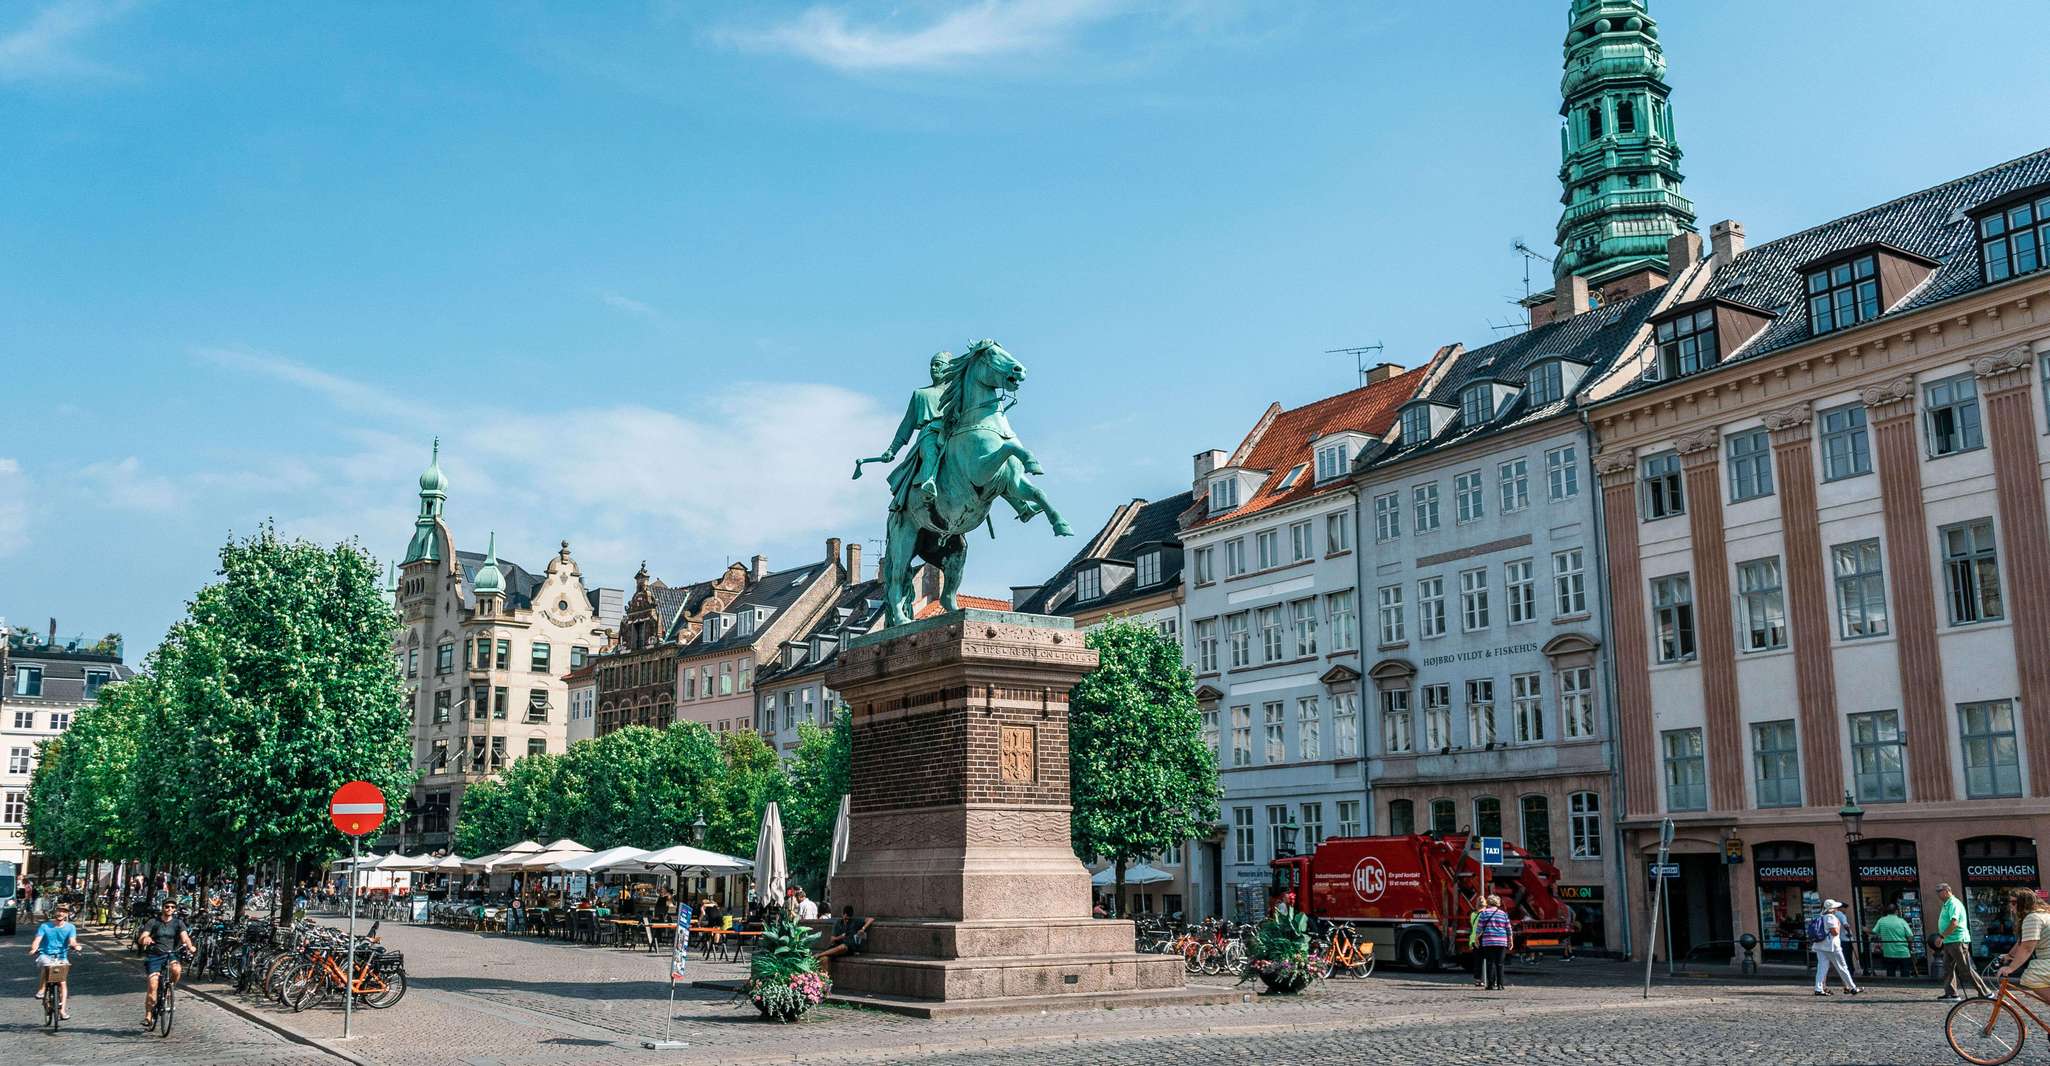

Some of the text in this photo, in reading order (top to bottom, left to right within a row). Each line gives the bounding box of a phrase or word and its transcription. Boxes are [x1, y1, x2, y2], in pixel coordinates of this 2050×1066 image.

[1423, 642, 1538, 668] HØJBRO VILDT & FISKEHUS
[1485, 847, 1500, 855] TAXI
[1759, 867, 1814, 877] COPENHAGEN
[1967, 865, 2035, 876] COPENHAGEN
[1356, 865, 1383, 894] HCS
[1560, 887, 1579, 898] WOK
